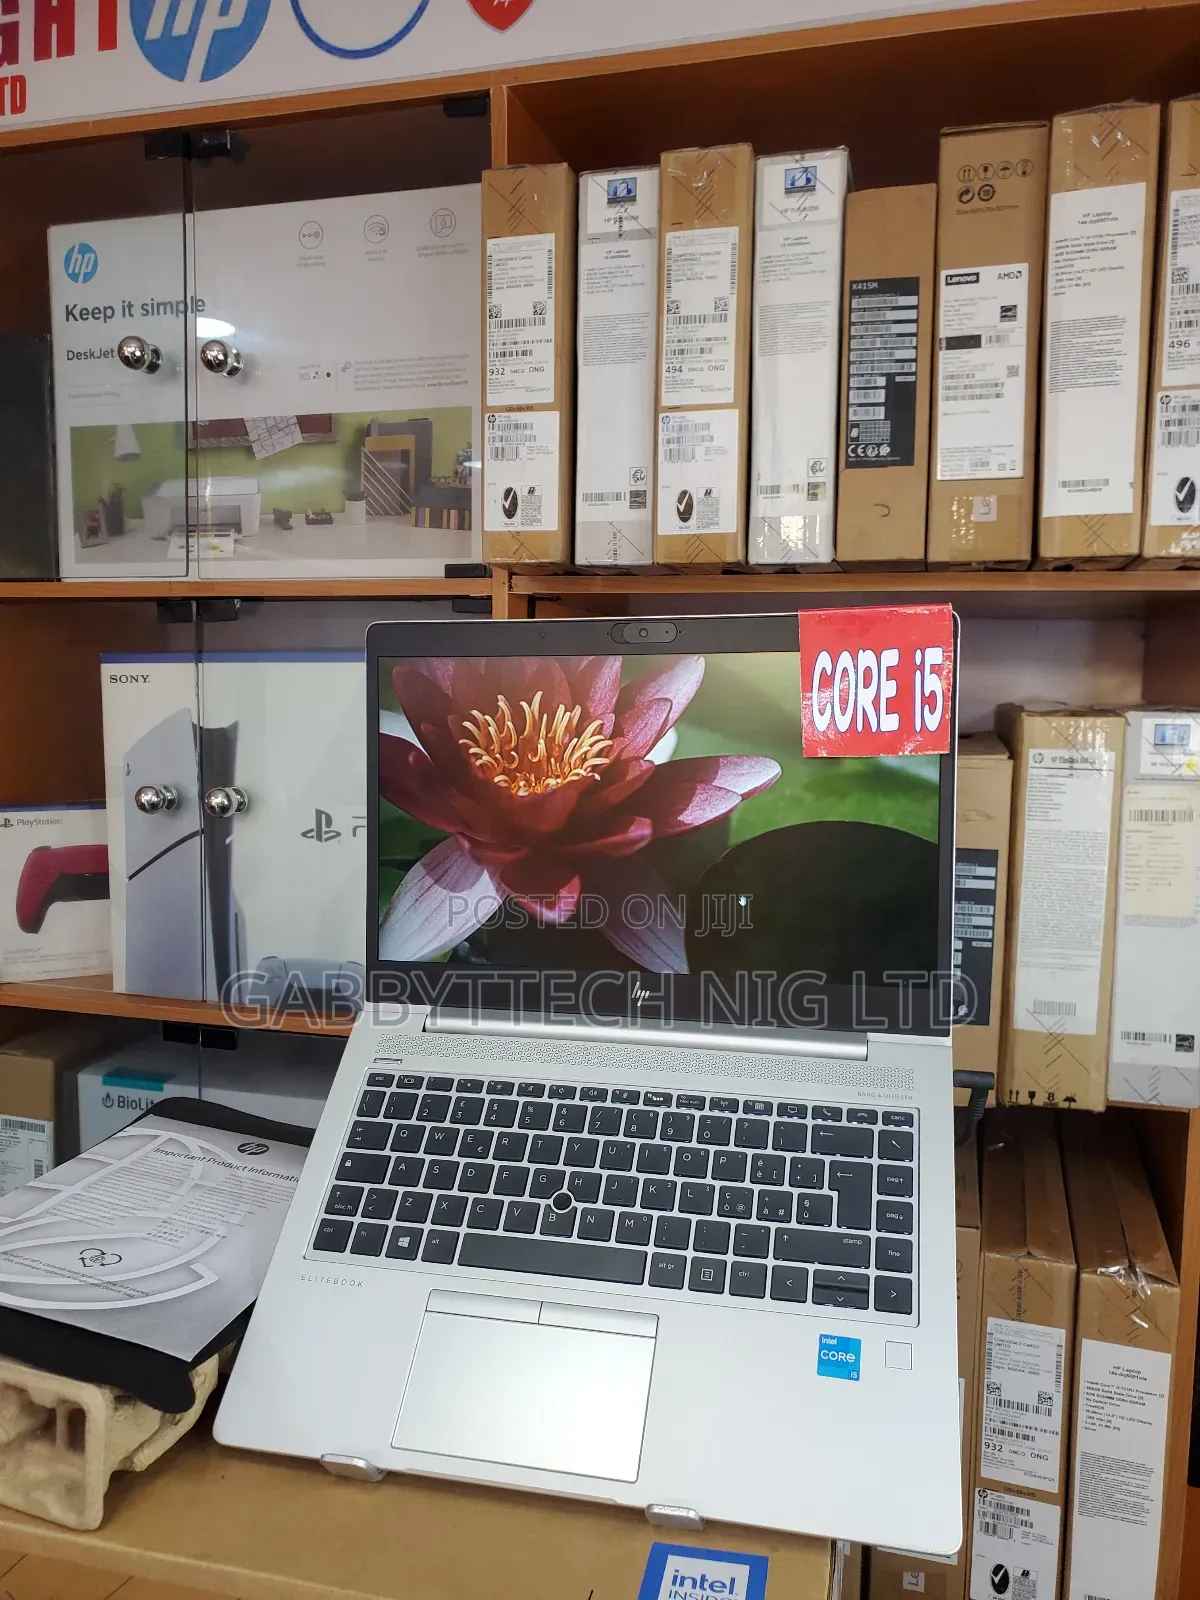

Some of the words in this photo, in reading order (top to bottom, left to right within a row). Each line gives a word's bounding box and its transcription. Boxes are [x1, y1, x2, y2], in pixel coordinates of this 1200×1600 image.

[65, 243, 98, 284] hp
[947, 273, 978, 284] Lenovo
[997, 271, 1016, 280] AMD
[65, 304, 115, 323] Keep
[122, 299, 134, 318] it
[140, 295, 206, 318] simple
[1168, 338, 1191, 349] 496
[66, 348, 115, 361] DeskJet
[488, 367, 506, 376] 932
[528, 365, 545, 373] ONG
[665, 365, 683, 374] 494
[109, 674, 150, 684] SONY
[811, 647, 900, 733] CORE
[913, 645, 945, 733] i5
[16, 817, 62, 827] PlayStation
[117, 1095, 155, 1111] BioLit
[422, 1108, 429, 1116] 2
[456, 1111, 462, 1119] 3
[524, 1116, 531, 1124] 5
[595, 1121, 601, 1129] 7
[631, 1124, 637, 1132] 8
[400, 1129, 408, 1138] Q
[667, 1127, 673, 1135] 9
[434, 1132, 445, 1140] W
[467, 1135, 475, 1143] E
[501, 1138, 509, 1146] R
[537, 1140, 544, 1148] T
[573, 1143, 580, 1151] Y
[609, 1146, 616, 1154] U
[153, 1147, 207, 1163] Important
[206, 1157, 247, 1172] Product
[248, 1166, 300, 1183] Informati
[719, 1156, 727, 1165] P
[398, 1163, 406, 1171] A
[432, 1166, 440, 1174] S
[467, 1168, 475, 1177] D
[502, 1171, 510, 1180] F
[539, 1175, 547, 1183] G
[574, 1178, 582, 1186] H
[611, 1181, 618, 1190] J
[650, 1185, 657, 1194] K
[687, 1188, 693, 1197] L
[405, 1198, 414, 1206] Z
[440, 1201, 449, 1210] X
[476, 1204, 484, 1213] C
[513, 1208, 522, 1217] V
[549, 1213, 556, 1222] B
[586, 1215, 595, 1224] N
[886, 1212, 899, 1220] pag
[624, 1219, 634, 1228] M
[842, 1237, 863, 1246] stamp
[300, 1274, 364, 1288] ELITEBOOK
[821, 1336, 837, 1346] intel
[850, 1371, 858, 1379] i5
[1122, 1366, 1141, 1375] Laptop
[984, 1441, 1003, 1453] 932
[1030, 1452, 1049, 1461] ONG
[672, 1569, 736, 1595] intel
